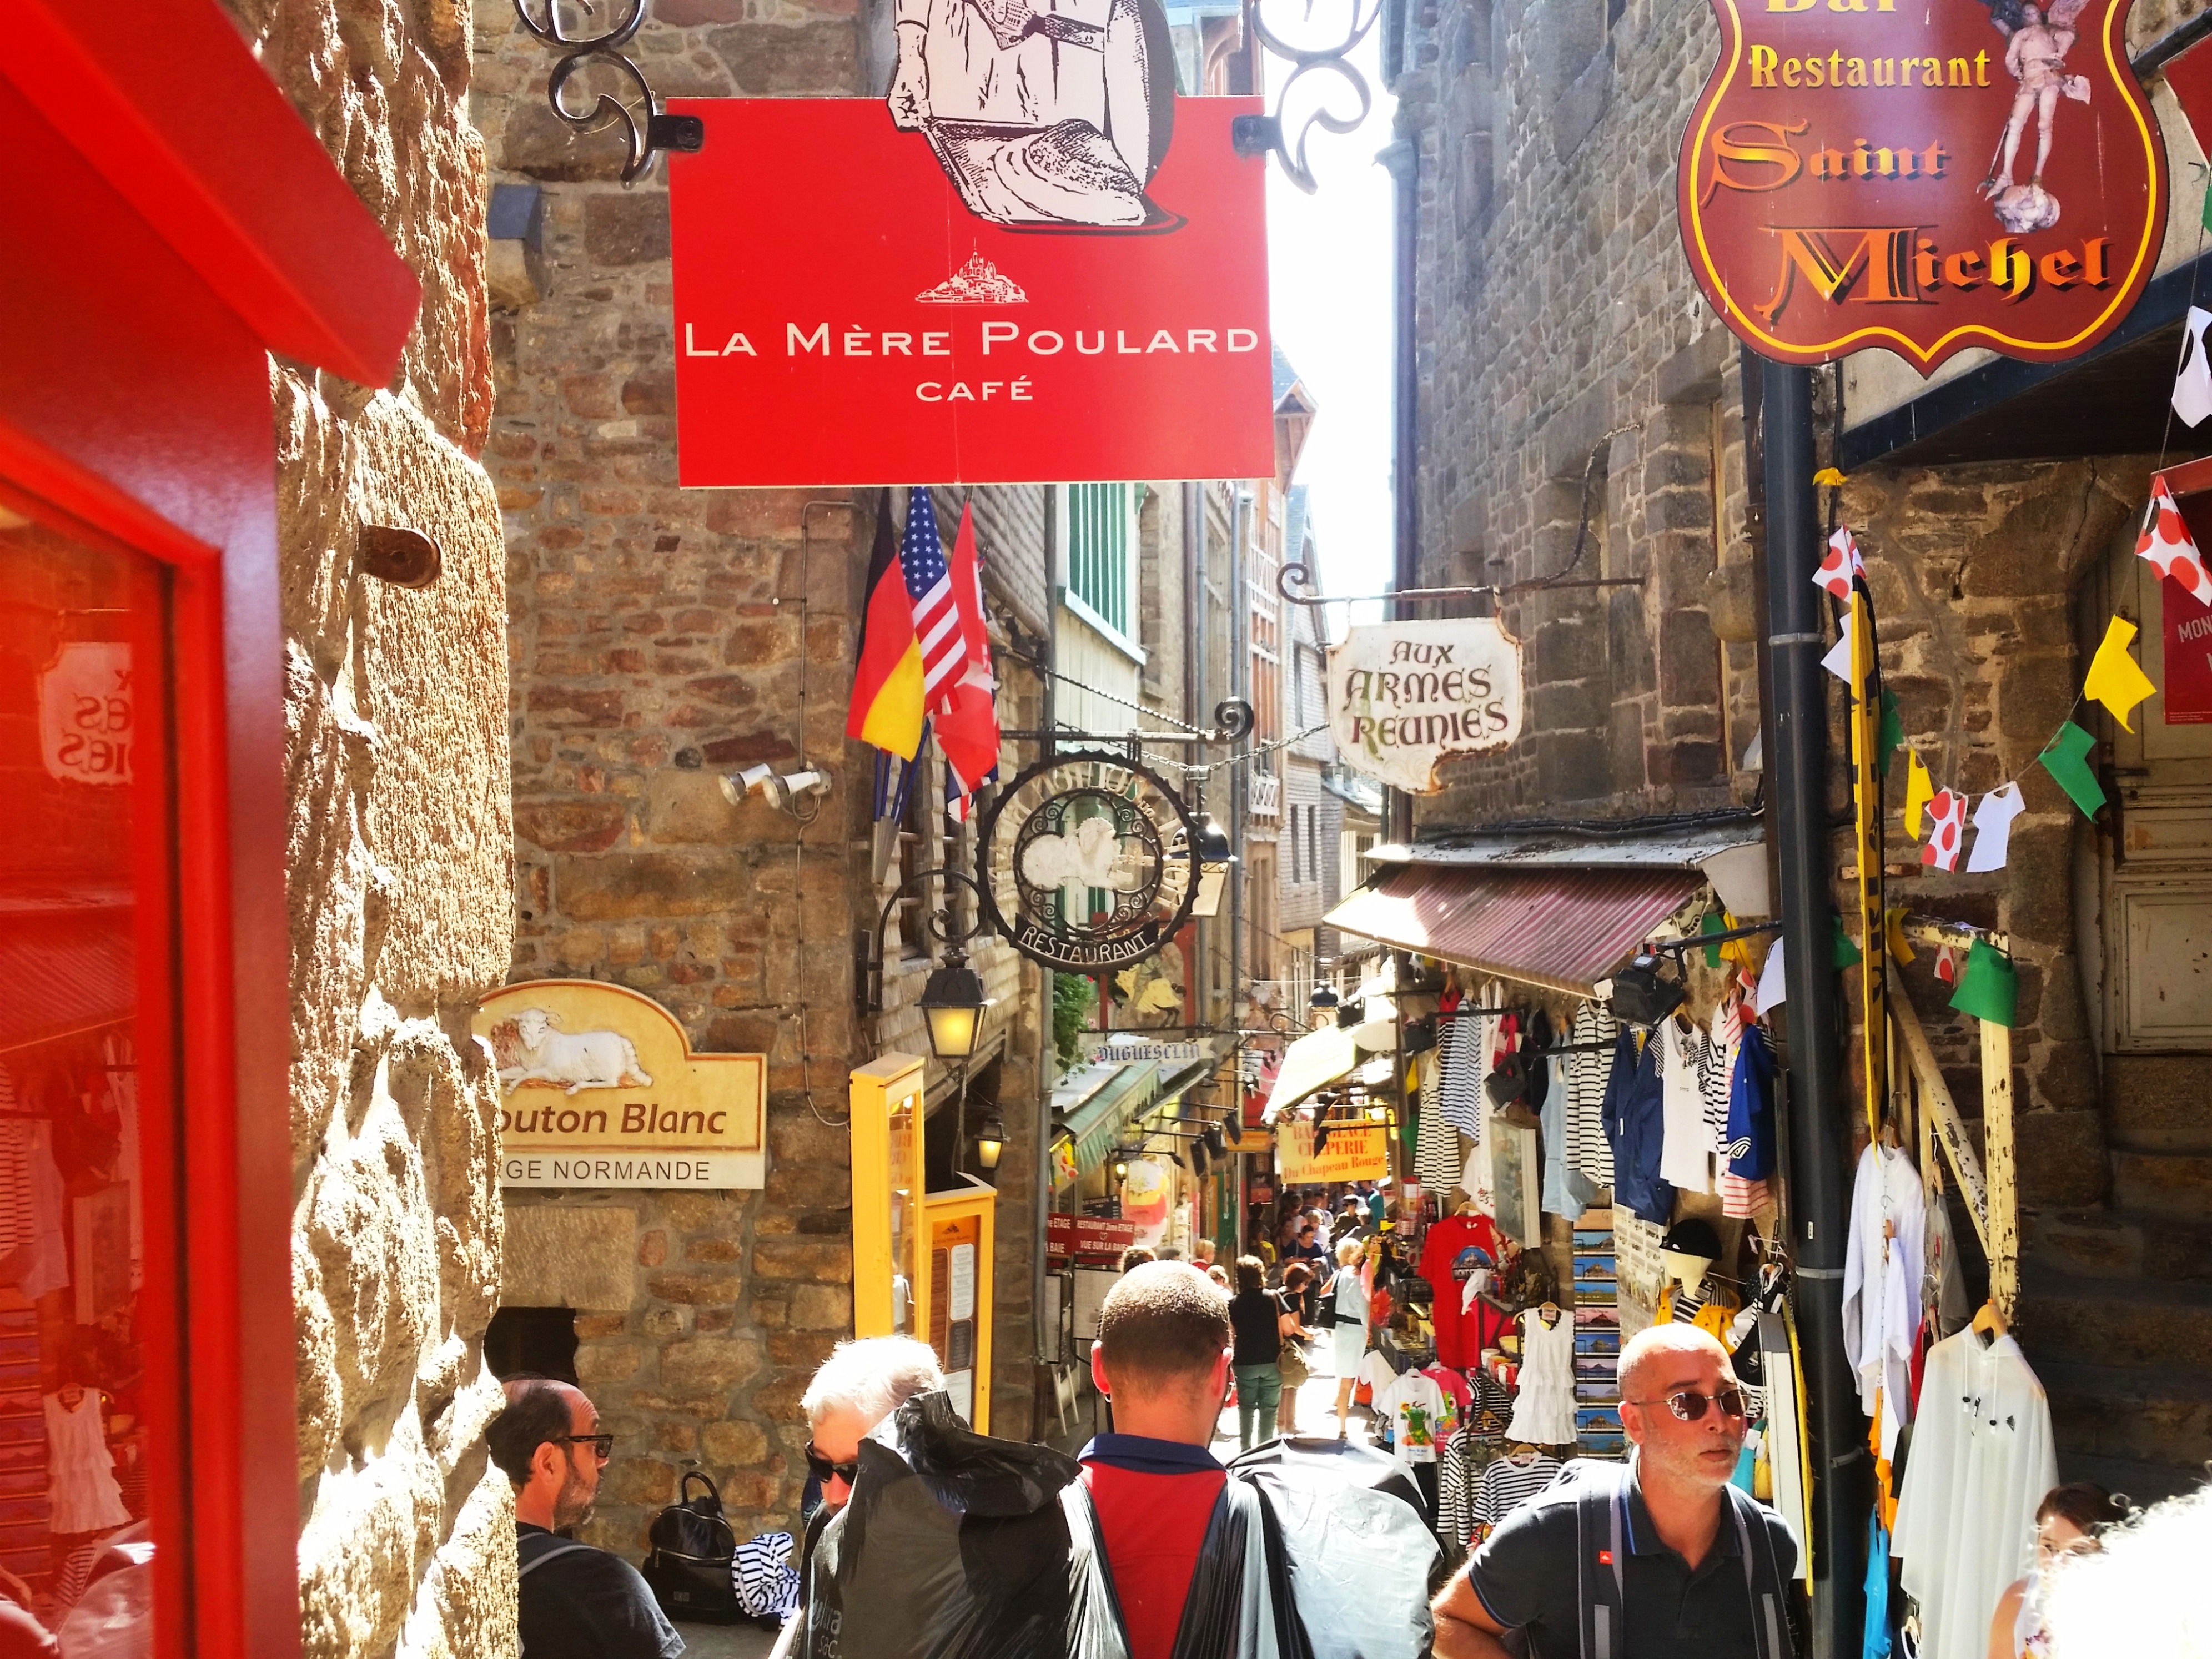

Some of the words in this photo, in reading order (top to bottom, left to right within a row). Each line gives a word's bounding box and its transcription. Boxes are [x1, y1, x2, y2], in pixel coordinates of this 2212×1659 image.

[1750, 44, 1991, 88] Restaurant
[1700, 118, 1950, 208] Saint
[1753, 224, 2112, 318] Michel
[685, 322, 757, 357] LA
[981, 320, 1258, 356] POULARD
[915, 374, 1034, 401] CAFÉ
[2178, 614, 2212, 643] MON
[1389, 640, 1455, 668] AUX
[1343, 664, 1491, 711] ARMES
[1022, 926, 1147, 963] RESTAURANT
[621, 1103, 726, 1134] Blanc
[1298, 1140, 1368, 1156] CPERIE
[554, 1160, 709, 1180] NORMANDE
[1303, 1160, 1348, 1177] Chapeau
[1351, 1156, 1384, 1169] Rouge
[1077, 1220, 1106, 1230] RESTAURANT
[1080, 1240, 1092, 1249] VUE
[1092, 1241, 1104, 1250] SUR
[1105, 1241, 1112, 1251] LA
